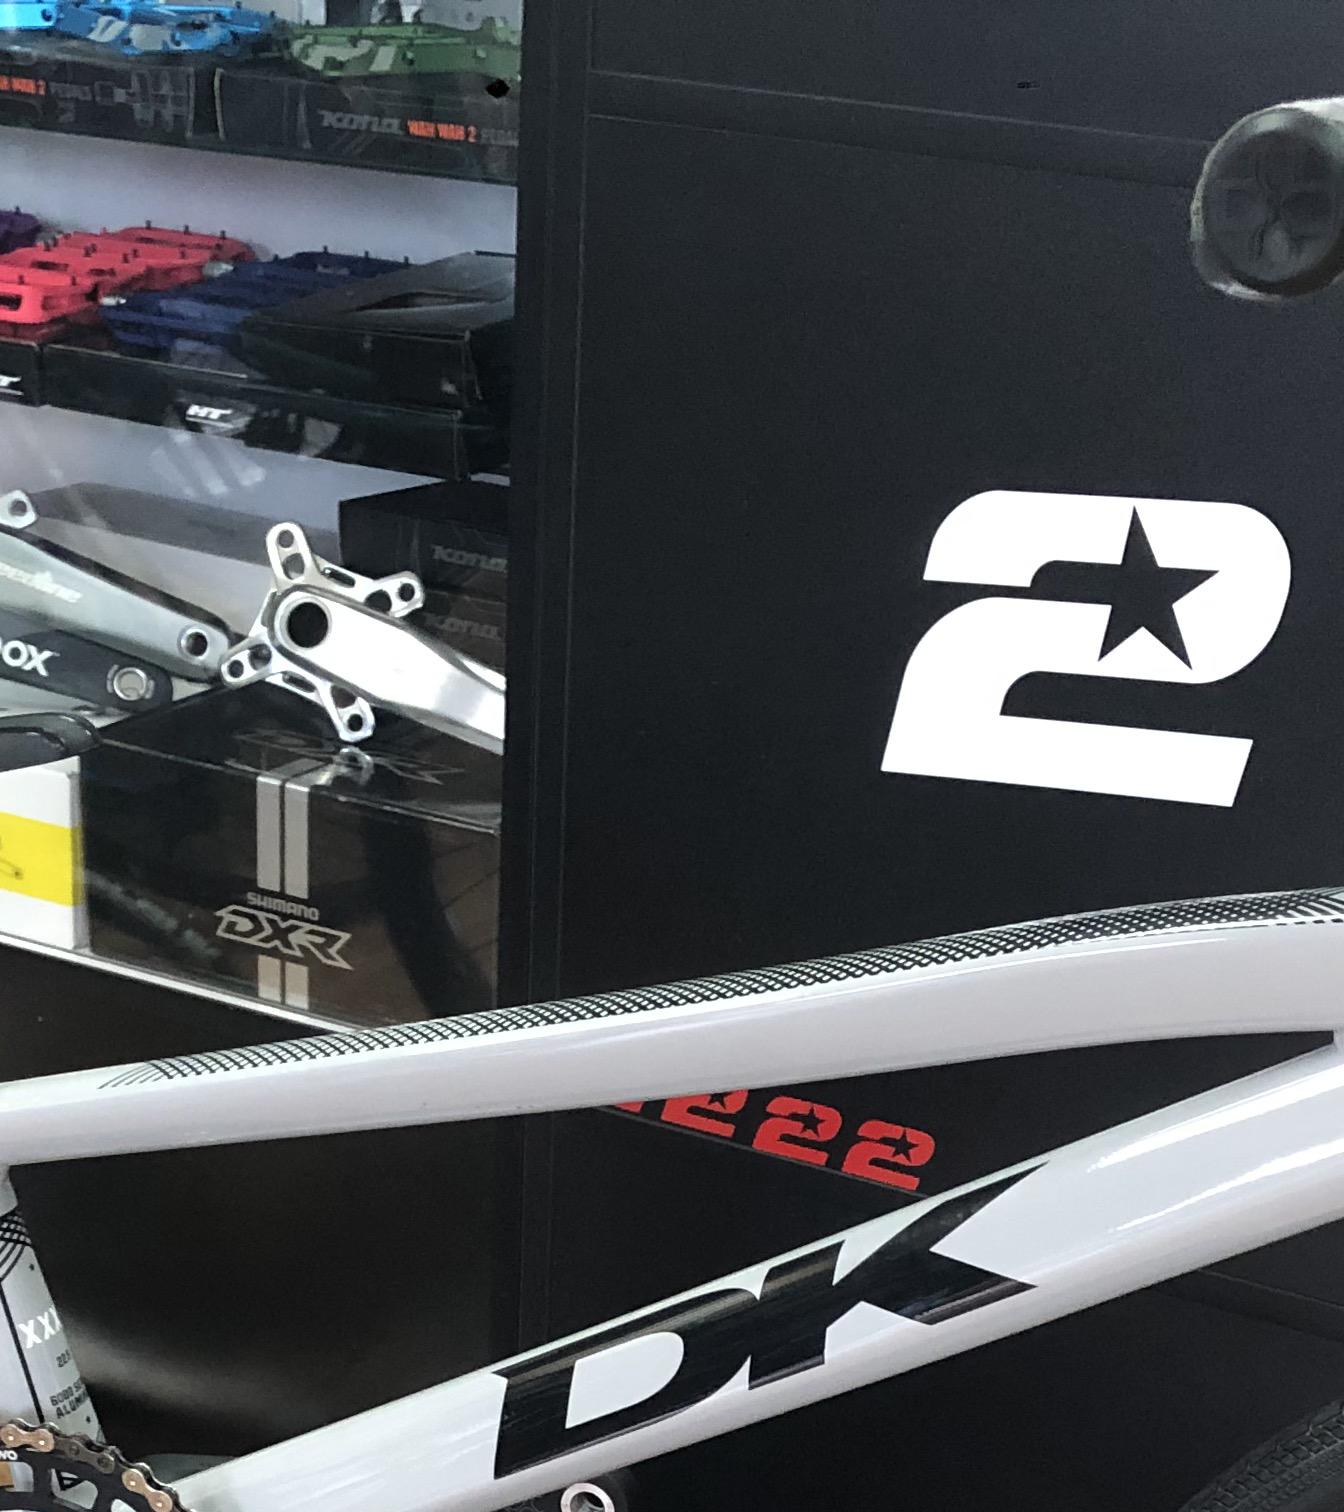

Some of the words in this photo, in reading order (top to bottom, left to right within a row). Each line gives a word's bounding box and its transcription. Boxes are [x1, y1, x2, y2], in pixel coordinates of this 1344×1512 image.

[214, 904, 353, 970] DXR
[247, 892, 320, 921] SHIMANO
[493, 1160, 1049, 1480] DK
